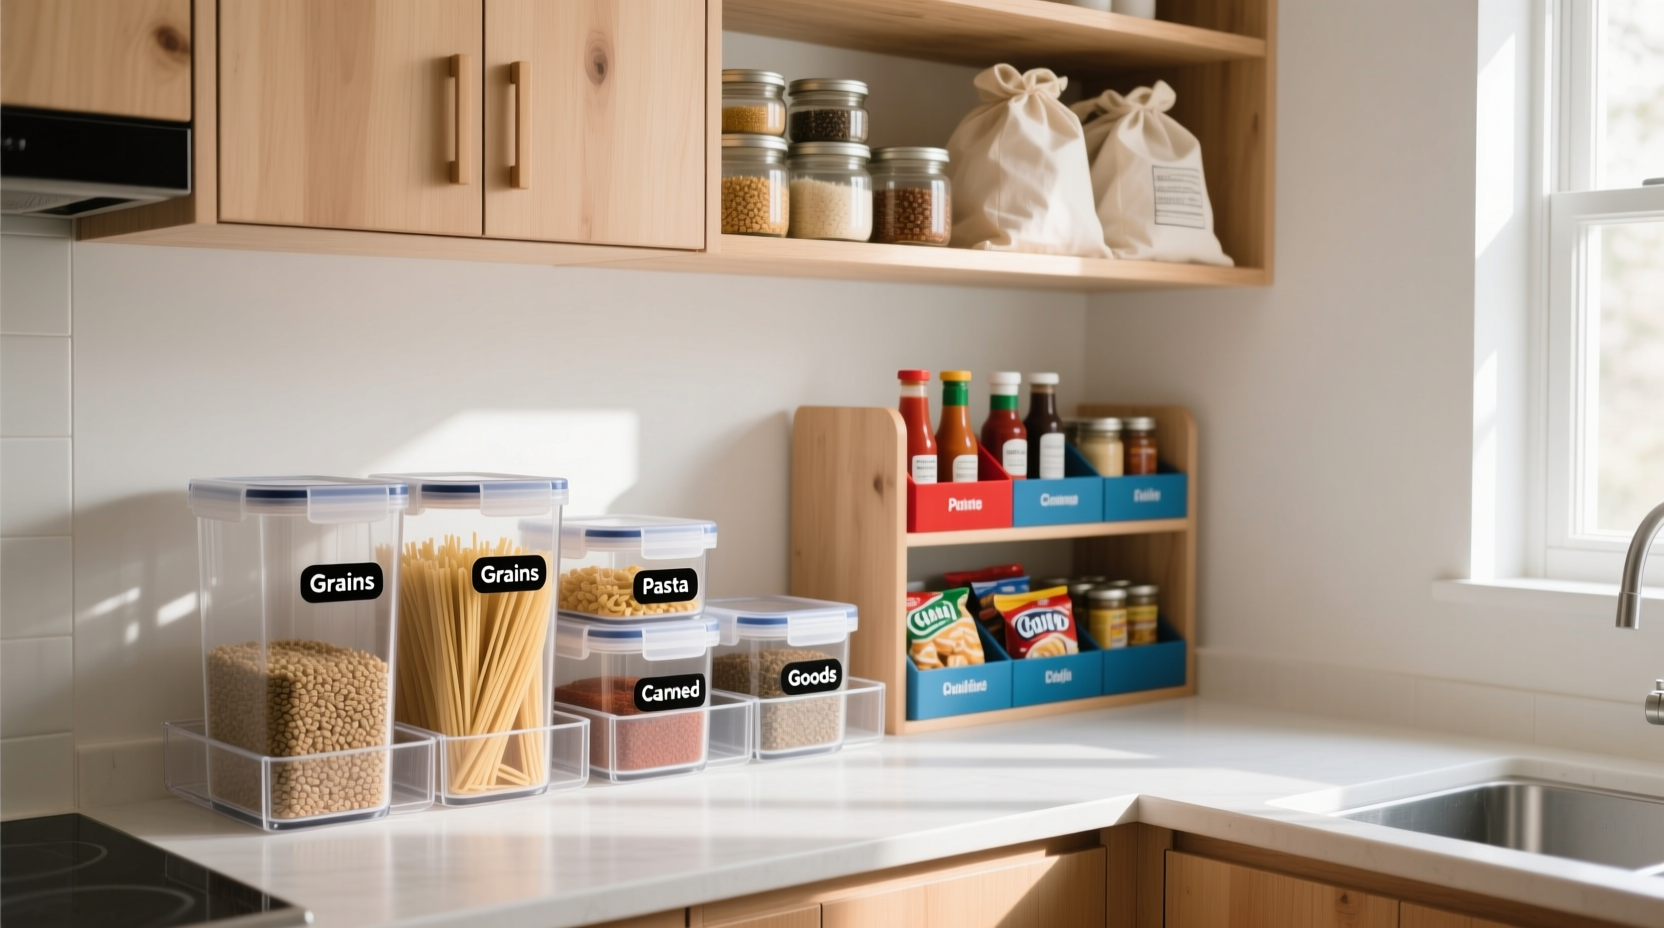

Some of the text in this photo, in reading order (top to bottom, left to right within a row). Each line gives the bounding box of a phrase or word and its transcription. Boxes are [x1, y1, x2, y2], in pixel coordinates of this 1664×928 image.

[309, 571, 375, 594] Grains
[480, 563, 540, 584] Grains
[642, 576, 689, 596] Pasta
[787, 665, 837, 687] Goods
